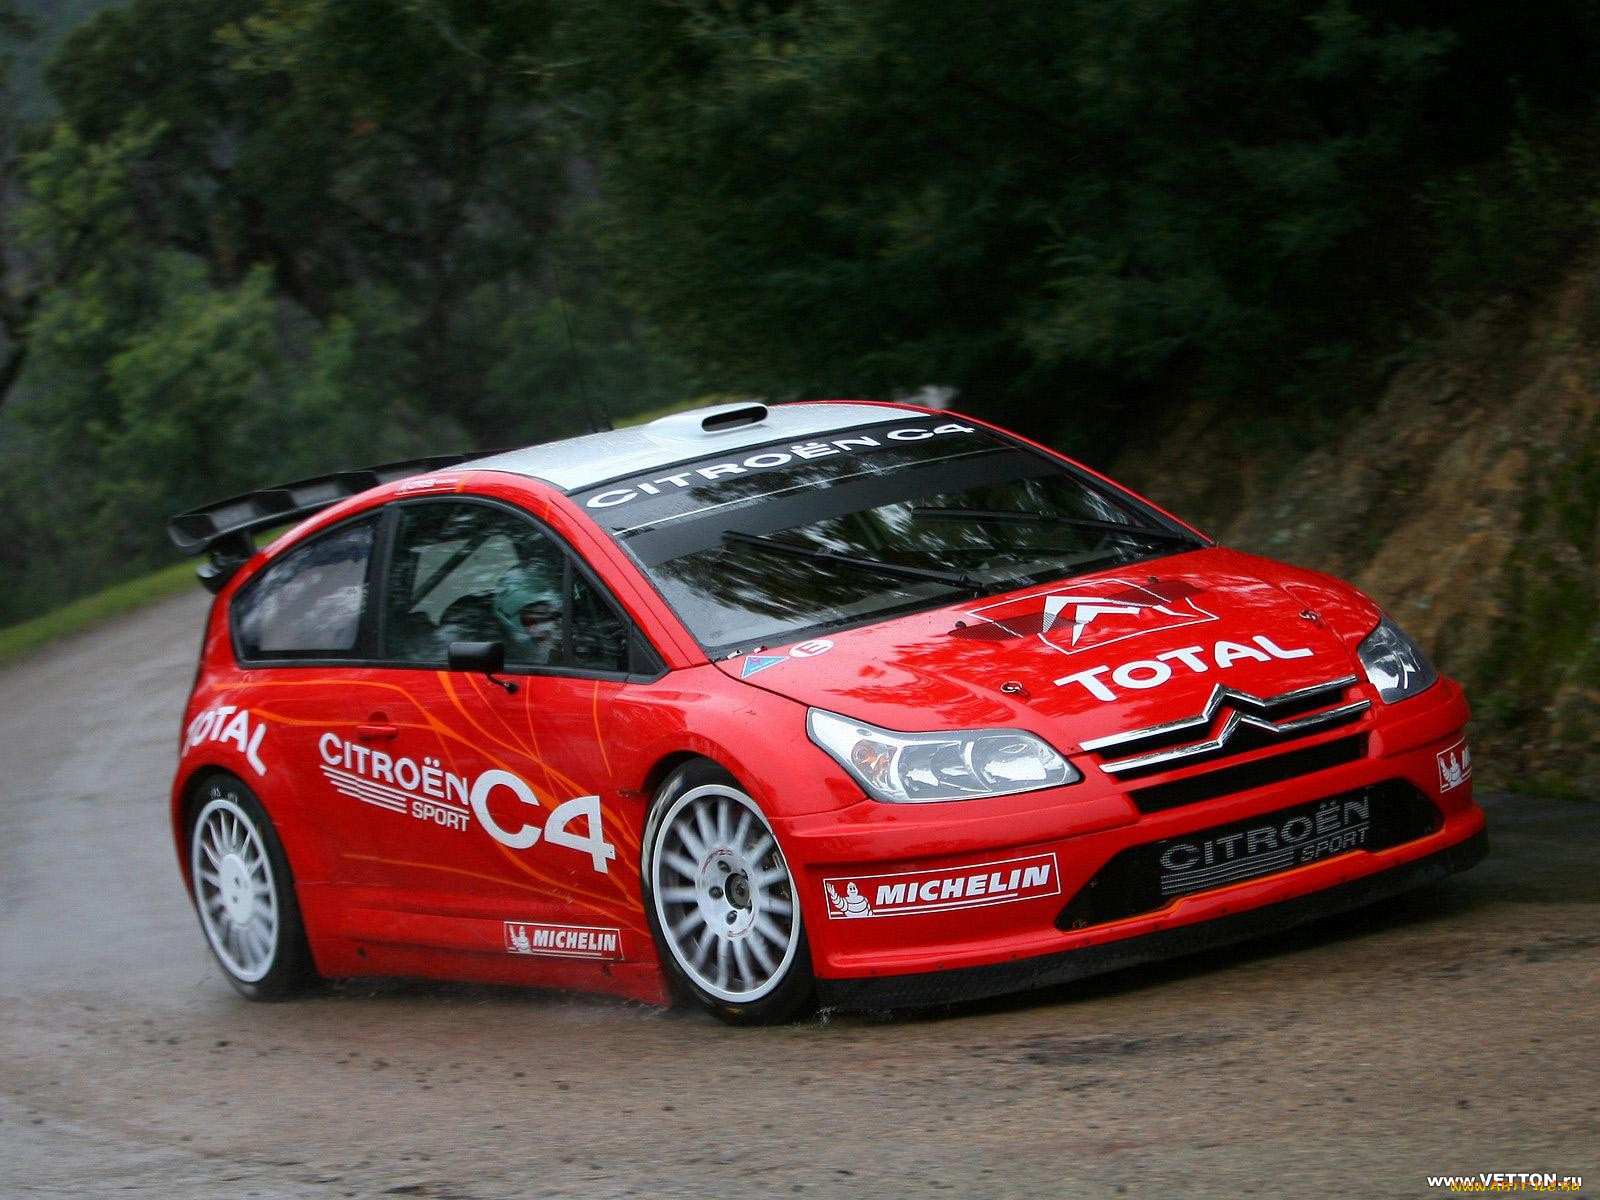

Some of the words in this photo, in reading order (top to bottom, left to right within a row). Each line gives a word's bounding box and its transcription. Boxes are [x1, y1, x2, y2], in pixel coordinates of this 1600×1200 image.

[586, 435, 881, 509] CITROËN
[886, 423, 975, 441] C4
[1053, 635, 1314, 702] TOTAL
[318, 732, 470, 806] CITROËN
[470, 769, 616, 875] C4
[411, 801, 471, 832] SPORT
[1160, 796, 1370, 871] CITROËN
[1300, 826, 1370, 863] SPORT
[875, 864, 1051, 906] MICHELIN
[532, 929, 616, 952] MICHELIN
